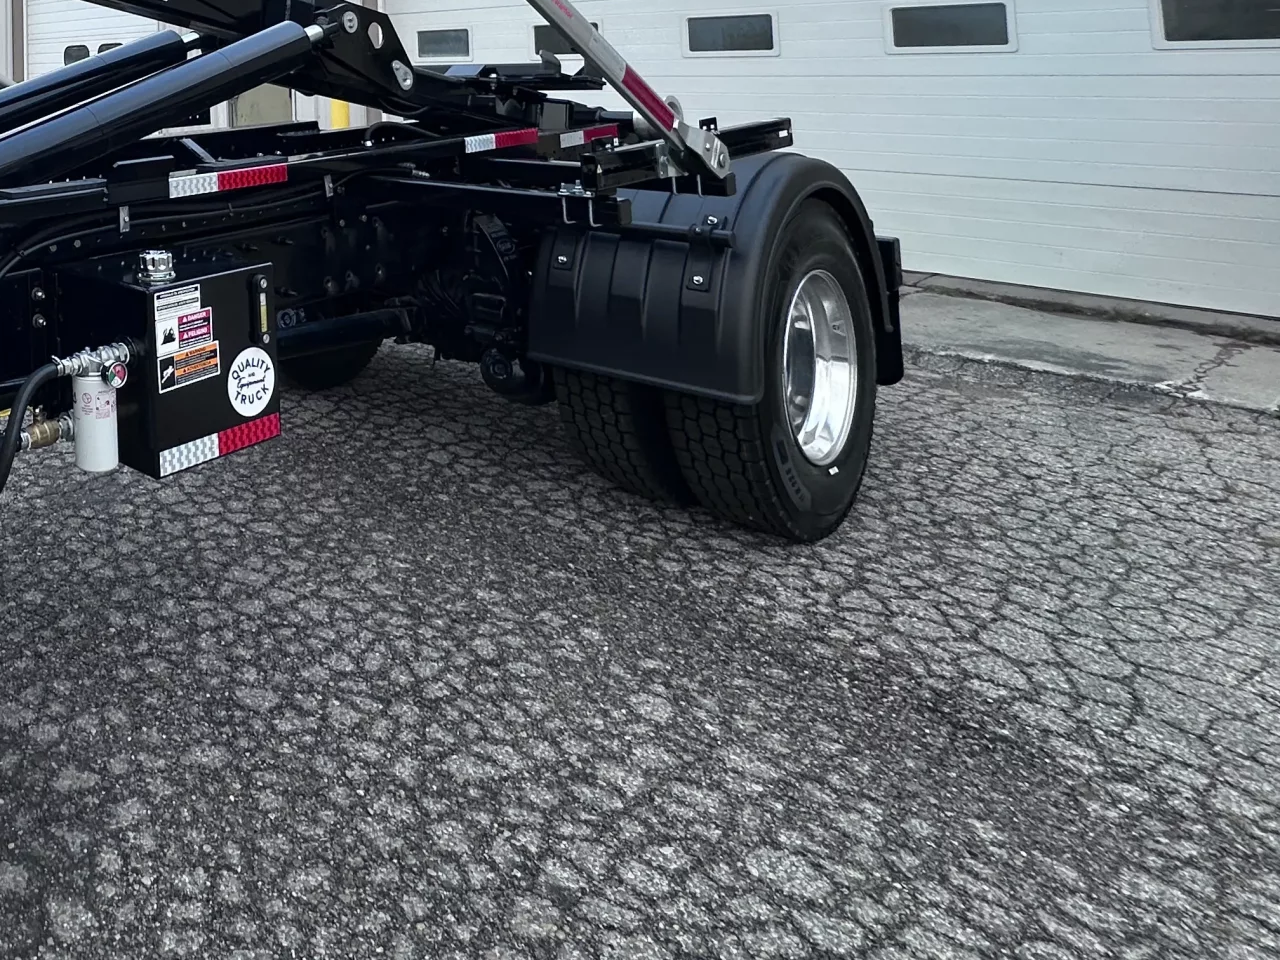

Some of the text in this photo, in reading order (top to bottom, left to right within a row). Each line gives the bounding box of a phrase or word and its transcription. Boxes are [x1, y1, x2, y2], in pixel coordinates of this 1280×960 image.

[187, 311, 207, 322] DANGER
[231, 357, 271, 381] QUALITY
[234, 383, 270, 405] TRUCK
